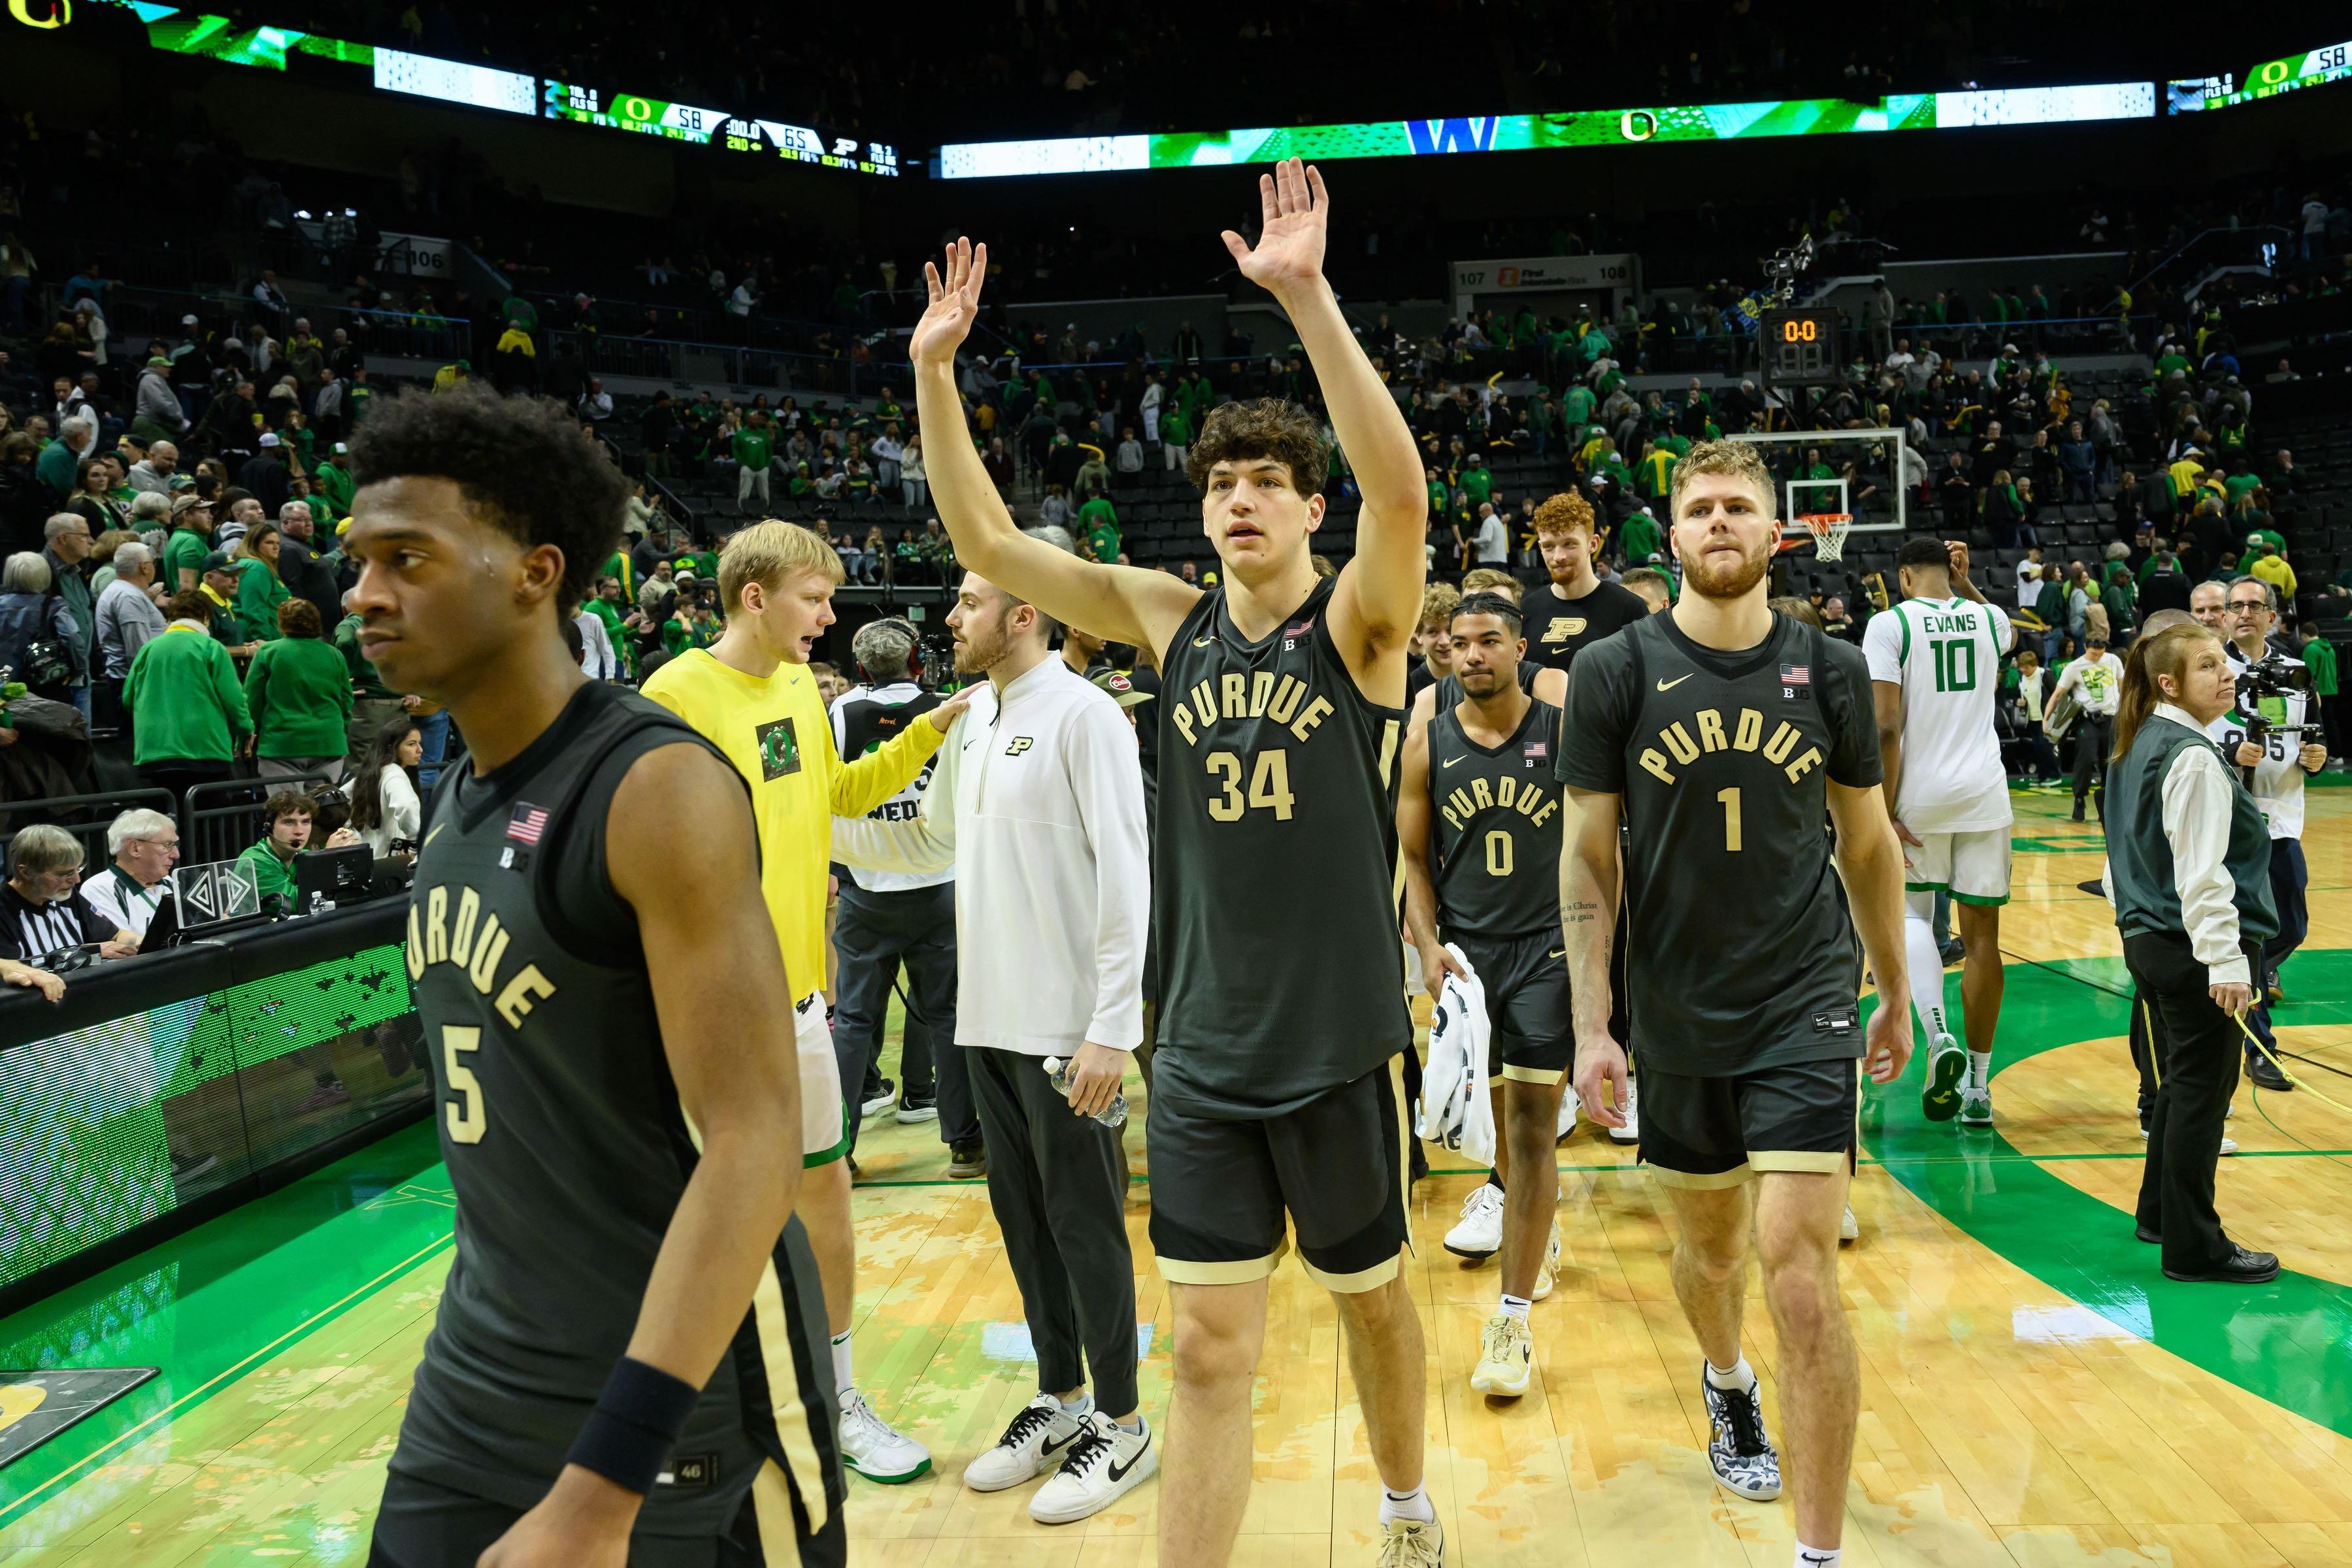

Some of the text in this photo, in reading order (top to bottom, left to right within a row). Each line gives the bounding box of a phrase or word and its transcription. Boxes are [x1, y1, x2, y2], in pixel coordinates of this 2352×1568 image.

[2320, 47, 2345, 70] 58
[679, 108, 701, 130] 58
[727, 136, 748, 151] 2ND
[785, 128, 806, 149] 65
[410, 250, 443, 269] 106
[1459, 272, 1485, 286] 107
[1600, 266, 1626, 280] 108
[1540, 617, 1587, 643] P
[1923, 613, 1977, 633] EVANS
[1929, 638, 1976, 693] 10
[1172, 670, 1335, 747] PURDUE
[1005, 736, 1034, 757] P
[1638, 707, 1824, 786] PURDUE
[1205, 749, 1295, 823] 34
[1442, 776, 1559, 832] PURDUE
[1716, 787, 1742, 851] 1
[1485, 829, 1514, 877] 0
[442, 1024, 487, 1145] 5
